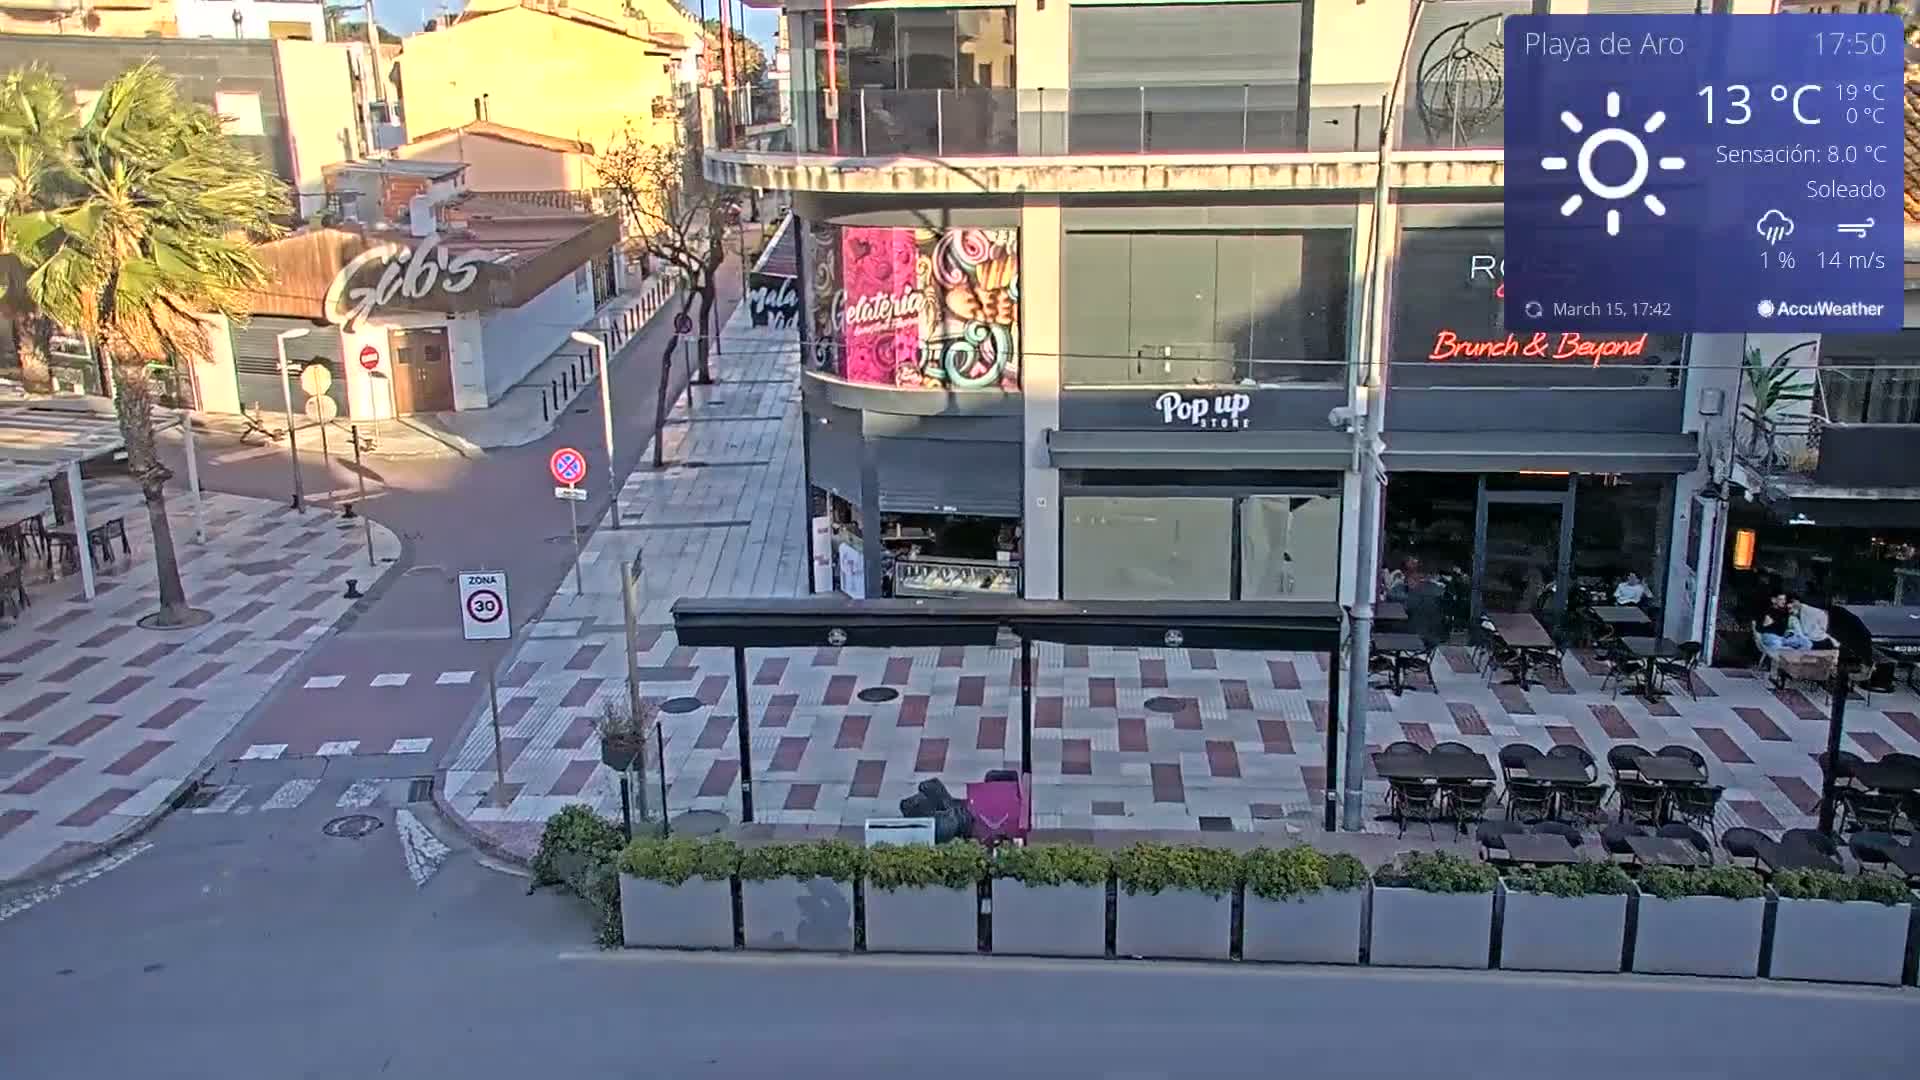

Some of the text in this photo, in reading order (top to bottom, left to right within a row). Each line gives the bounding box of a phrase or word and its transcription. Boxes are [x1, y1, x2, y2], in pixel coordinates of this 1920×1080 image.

[325, 232, 498, 330] Gib's
[1471, 254, 1504, 280] R
[831, 283, 926, 333] Gelateria
[1429, 331, 1648, 368] Brunch & Beyond
[1155, 391, 1250, 425] Pop up
[1200, 418, 1250, 428] STORE
[468, 576, 497, 585] ZONA
[474, 600, 495, 612] 30
